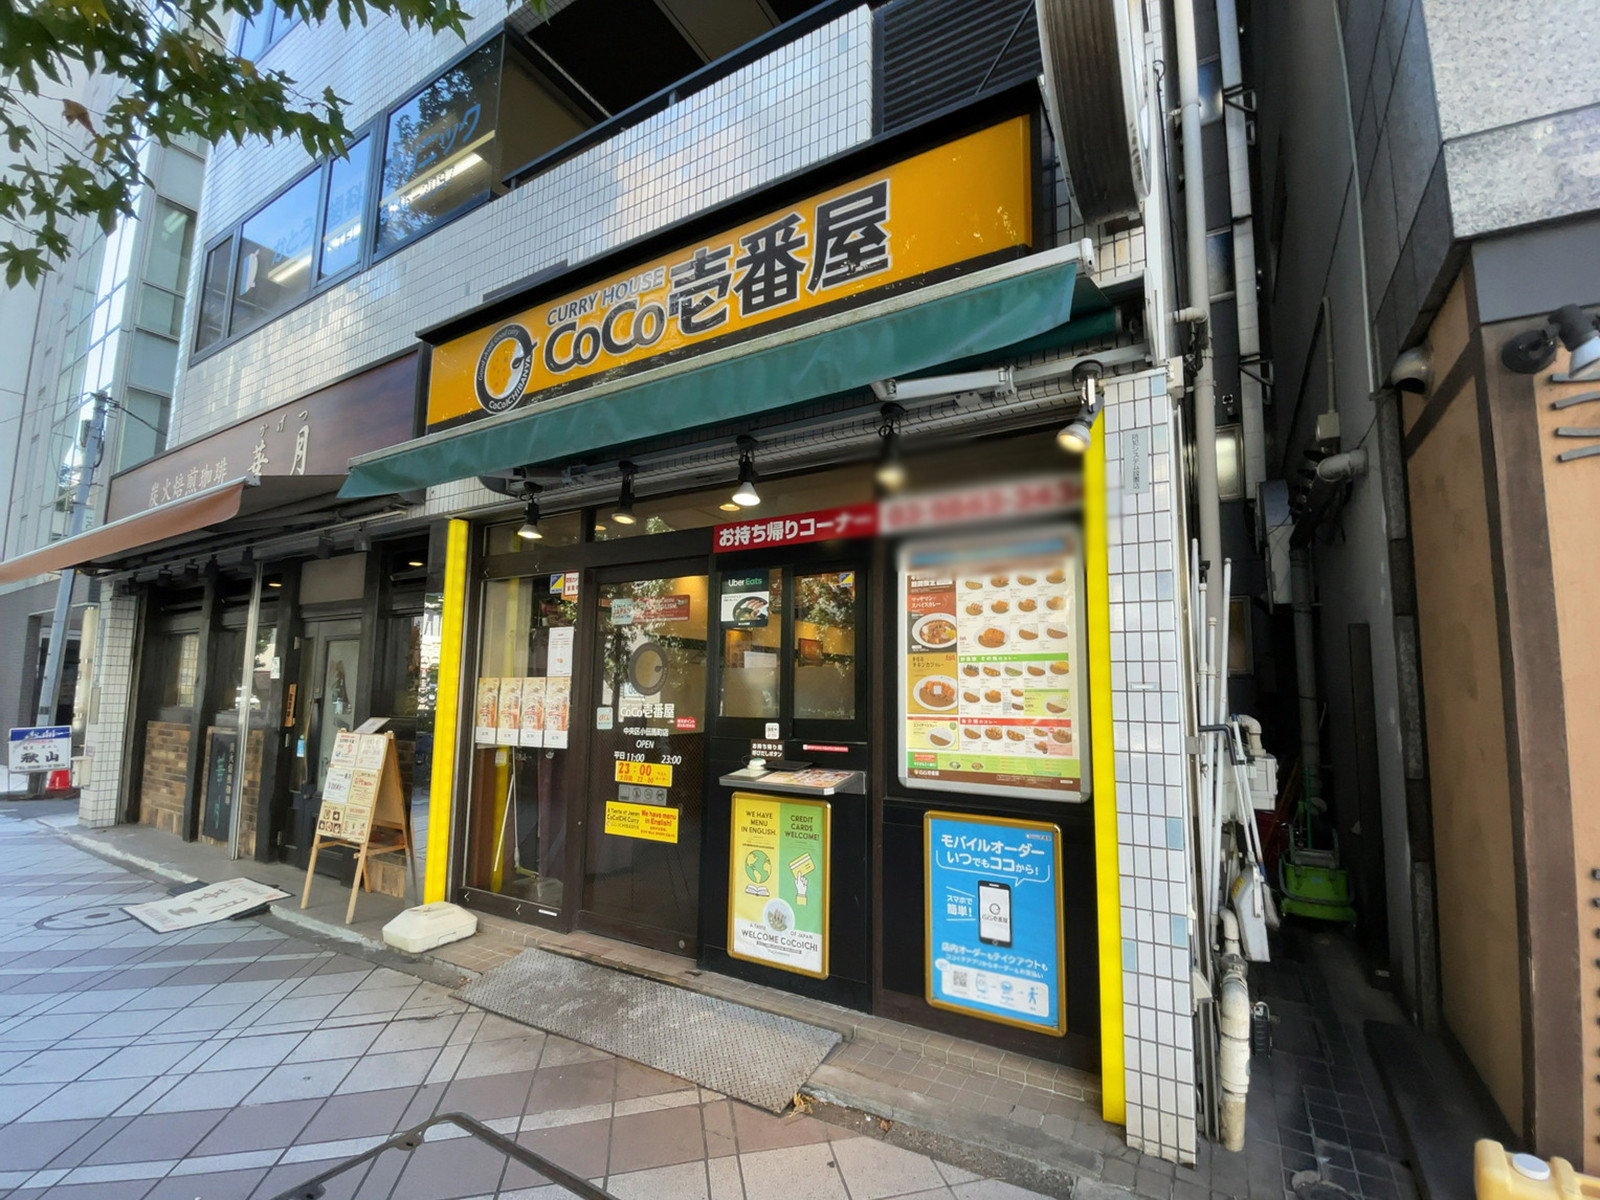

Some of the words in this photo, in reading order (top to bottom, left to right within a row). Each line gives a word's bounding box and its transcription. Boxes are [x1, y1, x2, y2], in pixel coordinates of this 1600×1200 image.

[547, 290, 598, 326] CURRY
[601, 265, 666, 307] HOUSE
[718, 510, 873, 547] お持ち帰りコーナー
[728, 579, 745, 588] Uber
[745, 577, 762, 586] Eats
[635, 739, 655, 749] OPEN
[626, 753, 645, 763] 11:00
[661, 755, 682, 765] 23:00
[649, 811, 662, 819] have
[756, 811, 773, 820] HAVE
[790, 815, 814, 824] CREDIT
[750, 819, 769, 827] MENU
[790, 823, 813, 832] CARDS
[784, 830, 820, 841] WELCOME!
[940, 834, 1045, 858] モバイルオーダー
[946, 894, 973, 905] スマホで
[741, 928, 779, 944] WELCOME
[780, 937, 818, 952] CoCoICHI
[797, 932, 814, 940] JAPAN
